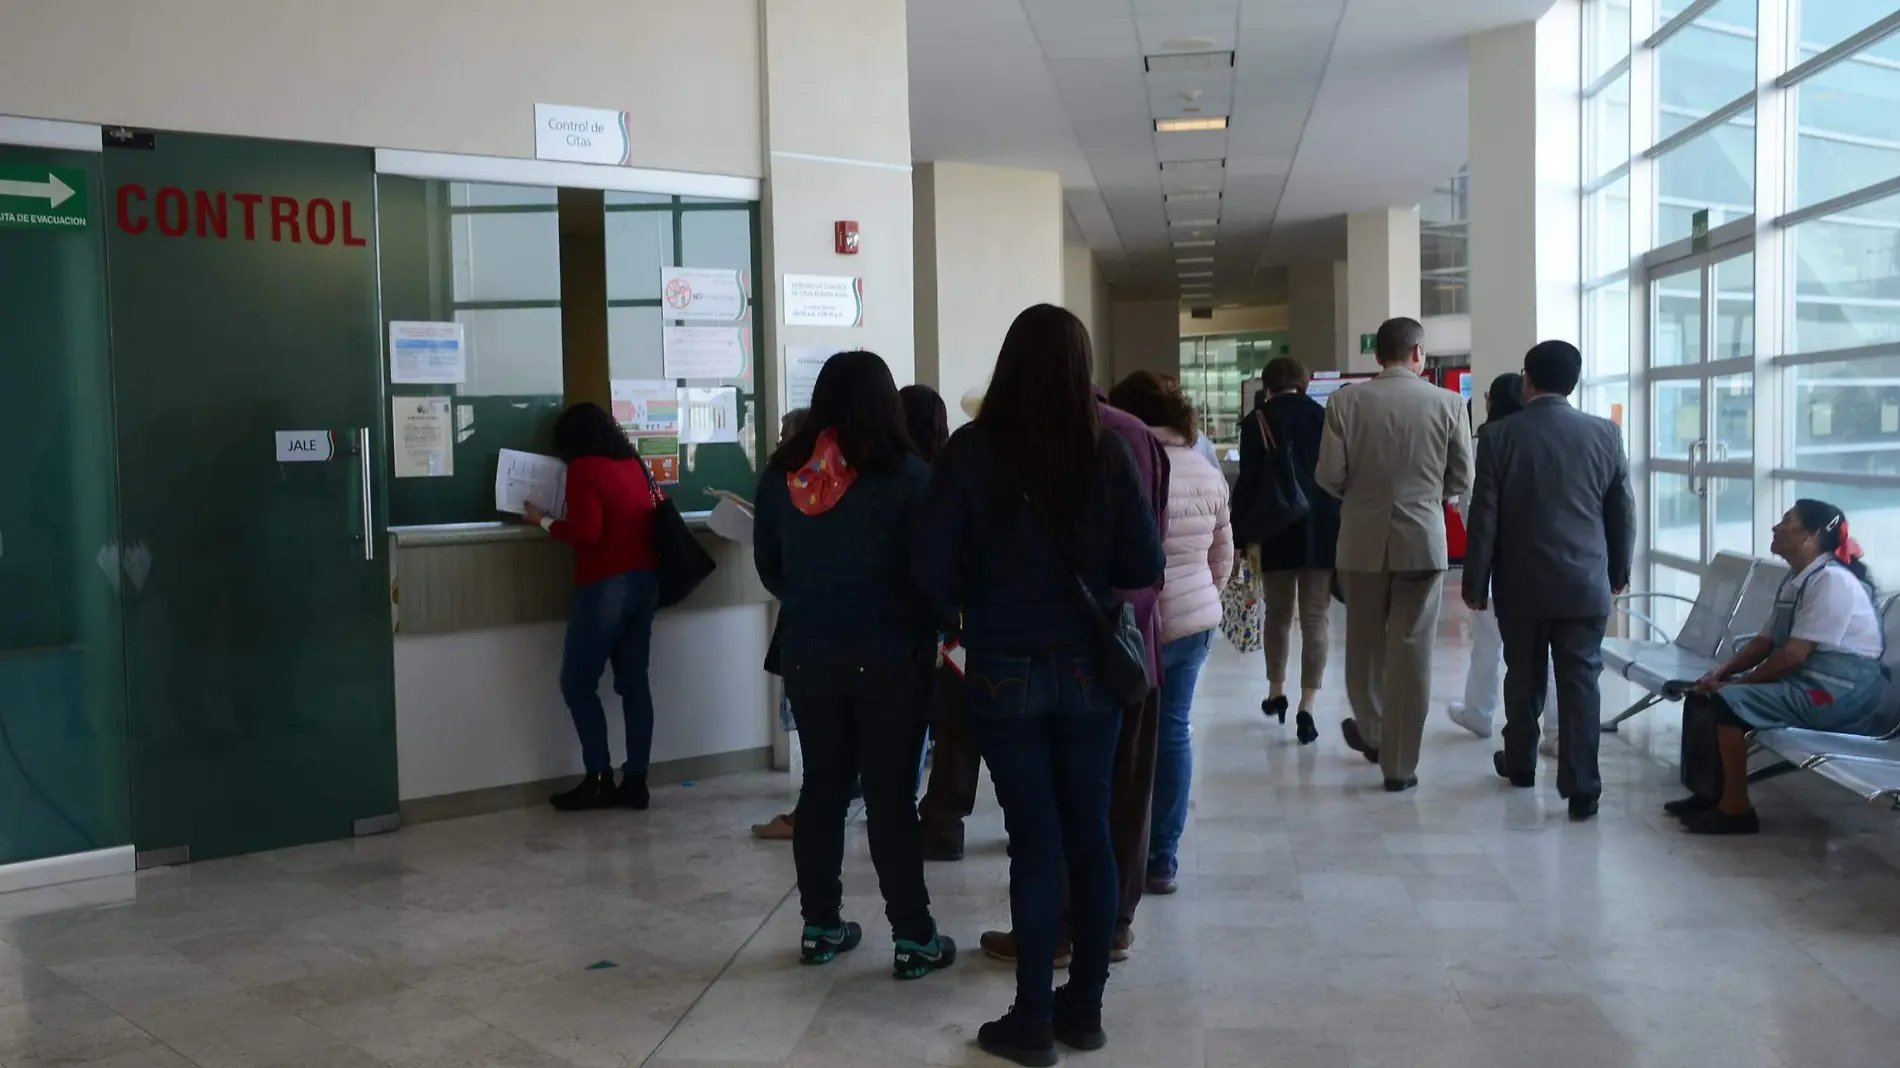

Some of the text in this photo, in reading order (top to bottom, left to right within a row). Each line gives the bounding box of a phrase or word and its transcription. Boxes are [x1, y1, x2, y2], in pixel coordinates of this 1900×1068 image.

[548, 118, 605, 134] Control de
[566, 134, 592, 147] Citas
[17, 213, 30, 223] DE
[30, 214, 87, 227] EVACUACION
[116, 183, 367, 247] CONTROL
[288, 439, 317, 452] JALE
